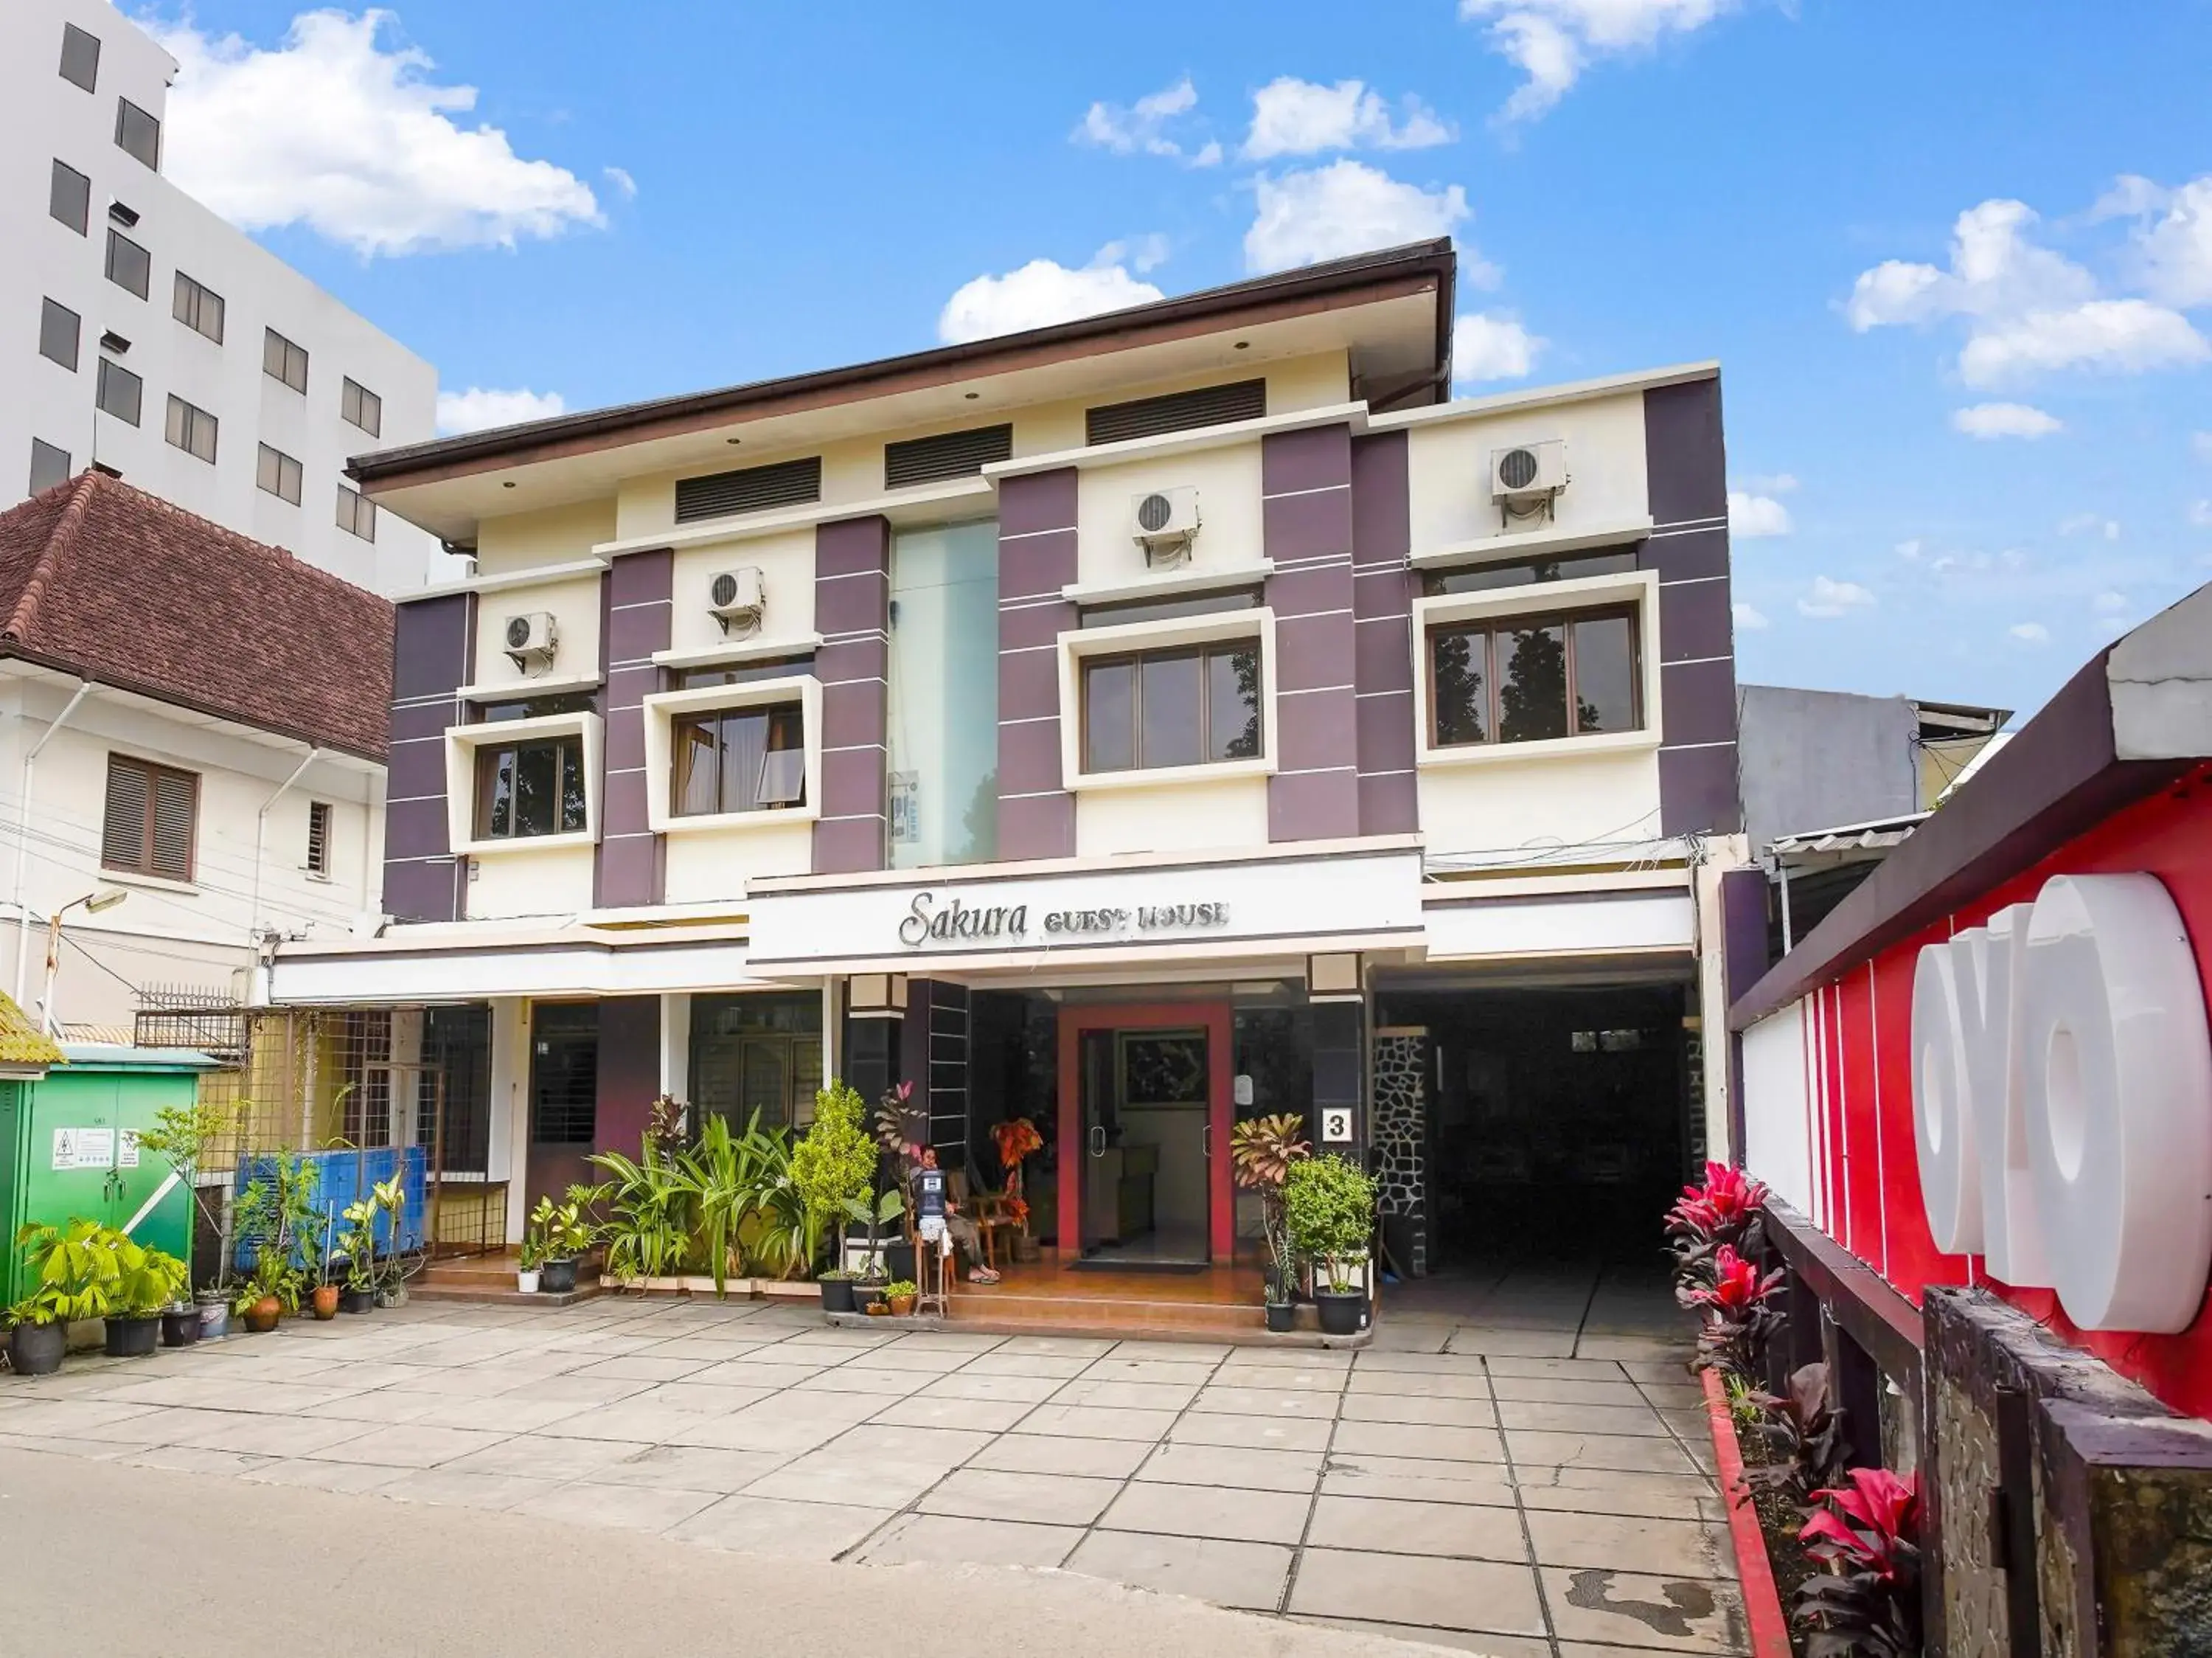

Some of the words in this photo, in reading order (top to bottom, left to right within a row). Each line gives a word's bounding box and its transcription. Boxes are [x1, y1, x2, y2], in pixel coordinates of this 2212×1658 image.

[898, 891, 1028, 946] Sakura
[1138, 901, 1230, 929] HOUSE
[1329, 1114, 1344, 1137] 3
[1911, 872, 2211, 1334] OYO
